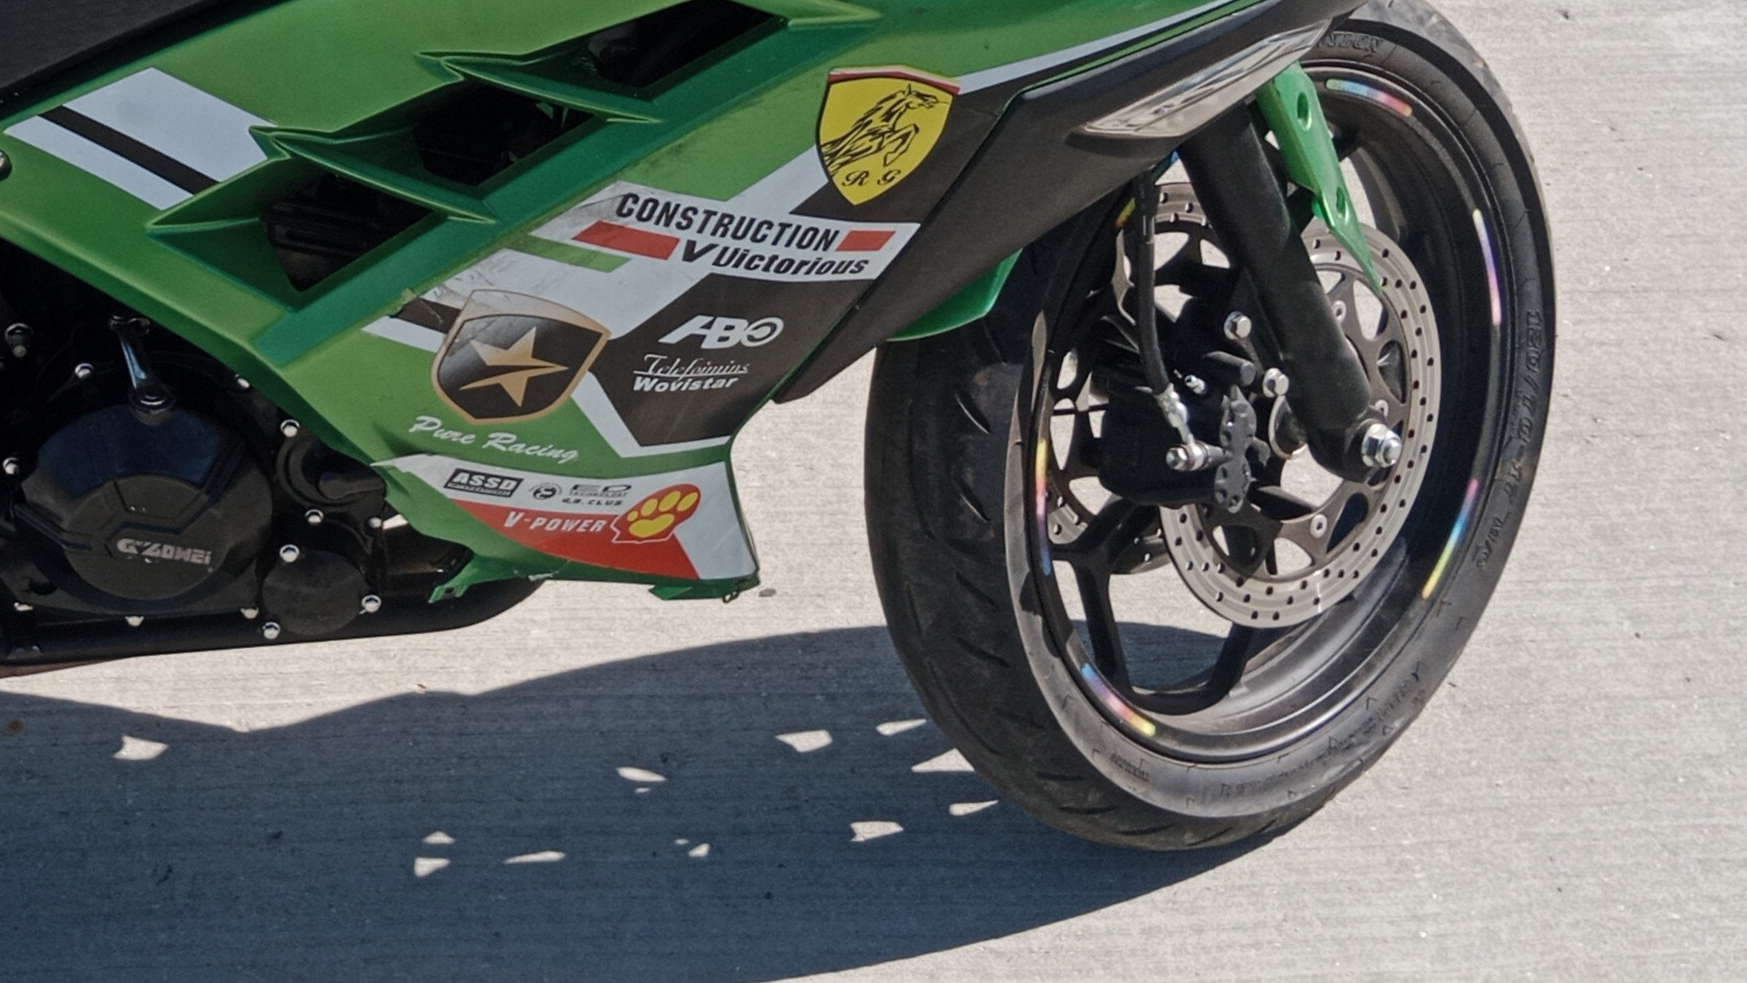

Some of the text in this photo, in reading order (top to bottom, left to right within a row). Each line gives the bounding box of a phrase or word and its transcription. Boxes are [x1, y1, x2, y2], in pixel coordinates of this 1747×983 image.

[841, 169, 901, 186] R G
[615, 192, 840, 252] CONSTRUCTION
[633, 375, 739, 393] Wovistar
[409, 415, 579, 464] Pure Racing
[504, 511, 607, 533] V-POWER
